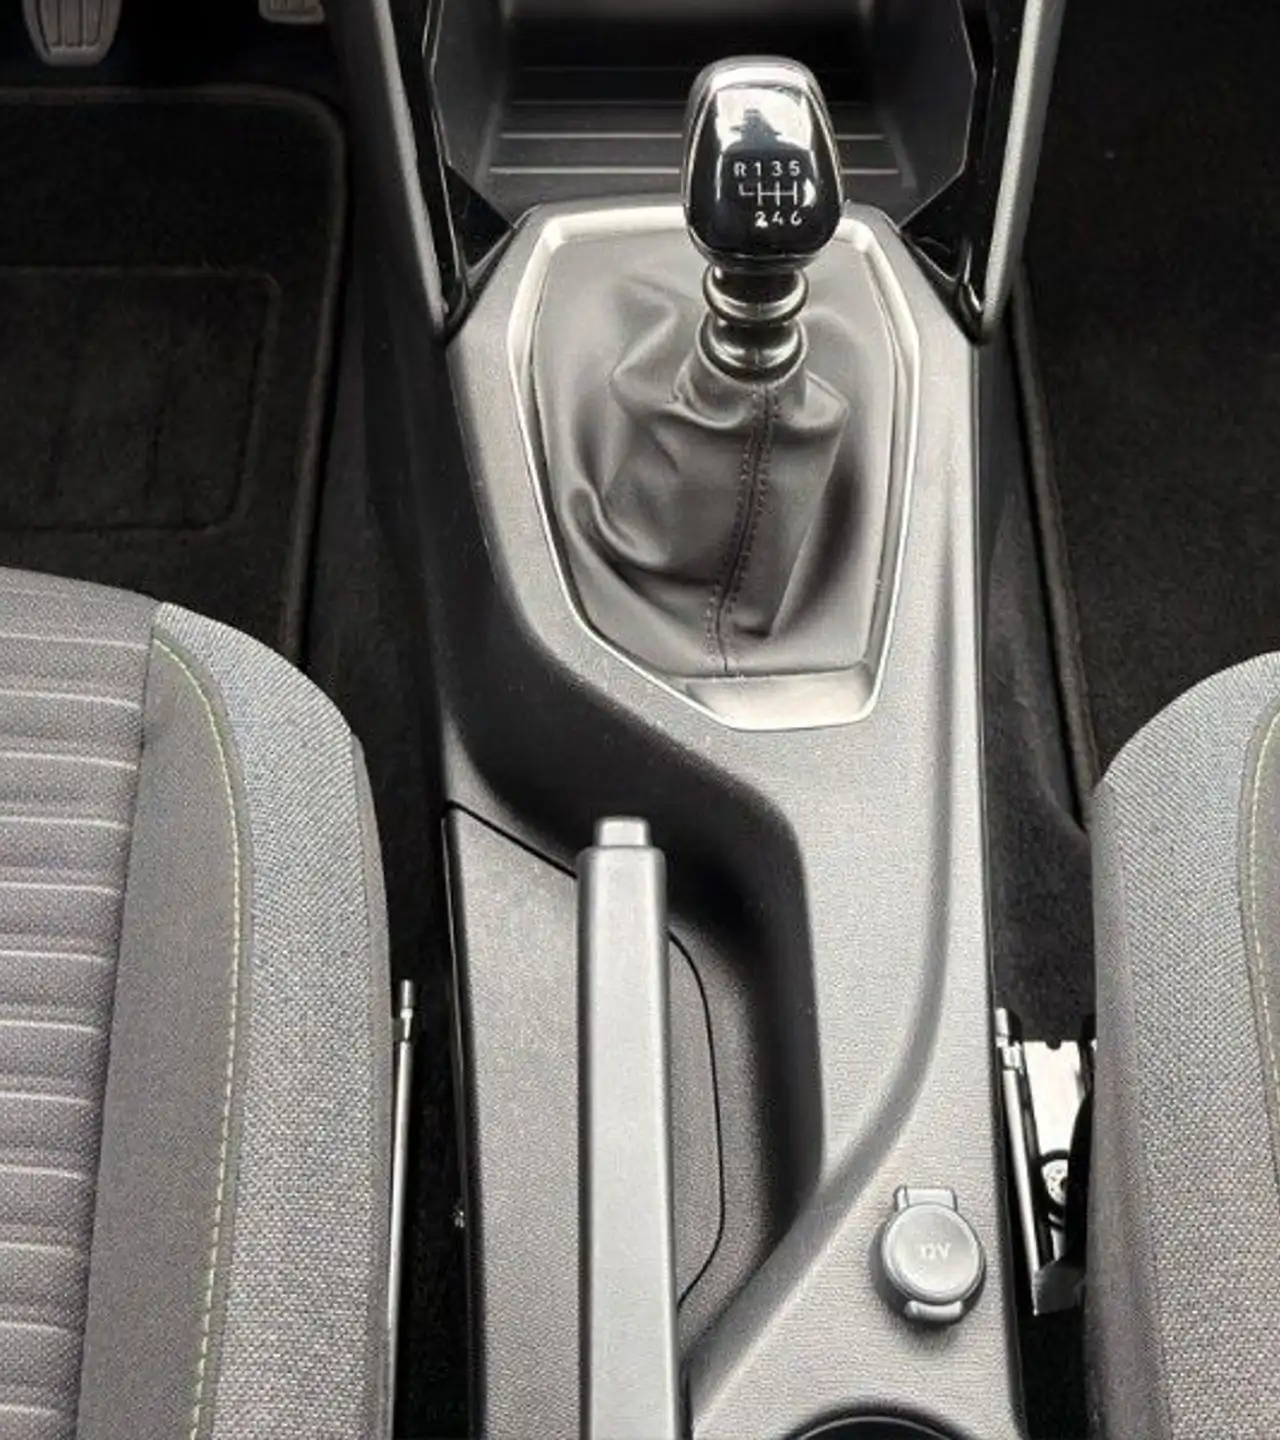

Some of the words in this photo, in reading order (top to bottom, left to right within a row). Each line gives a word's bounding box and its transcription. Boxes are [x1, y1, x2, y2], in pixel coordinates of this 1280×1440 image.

[734, 162, 747, 177] R
[754, 161, 762, 176] 1
[772, 161, 783, 176] 3
[789, 161, 800, 177] 5
[755, 211, 769, 228] 2
[772, 211, 784, 226] 4
[790, 211, 803, 226] 6
